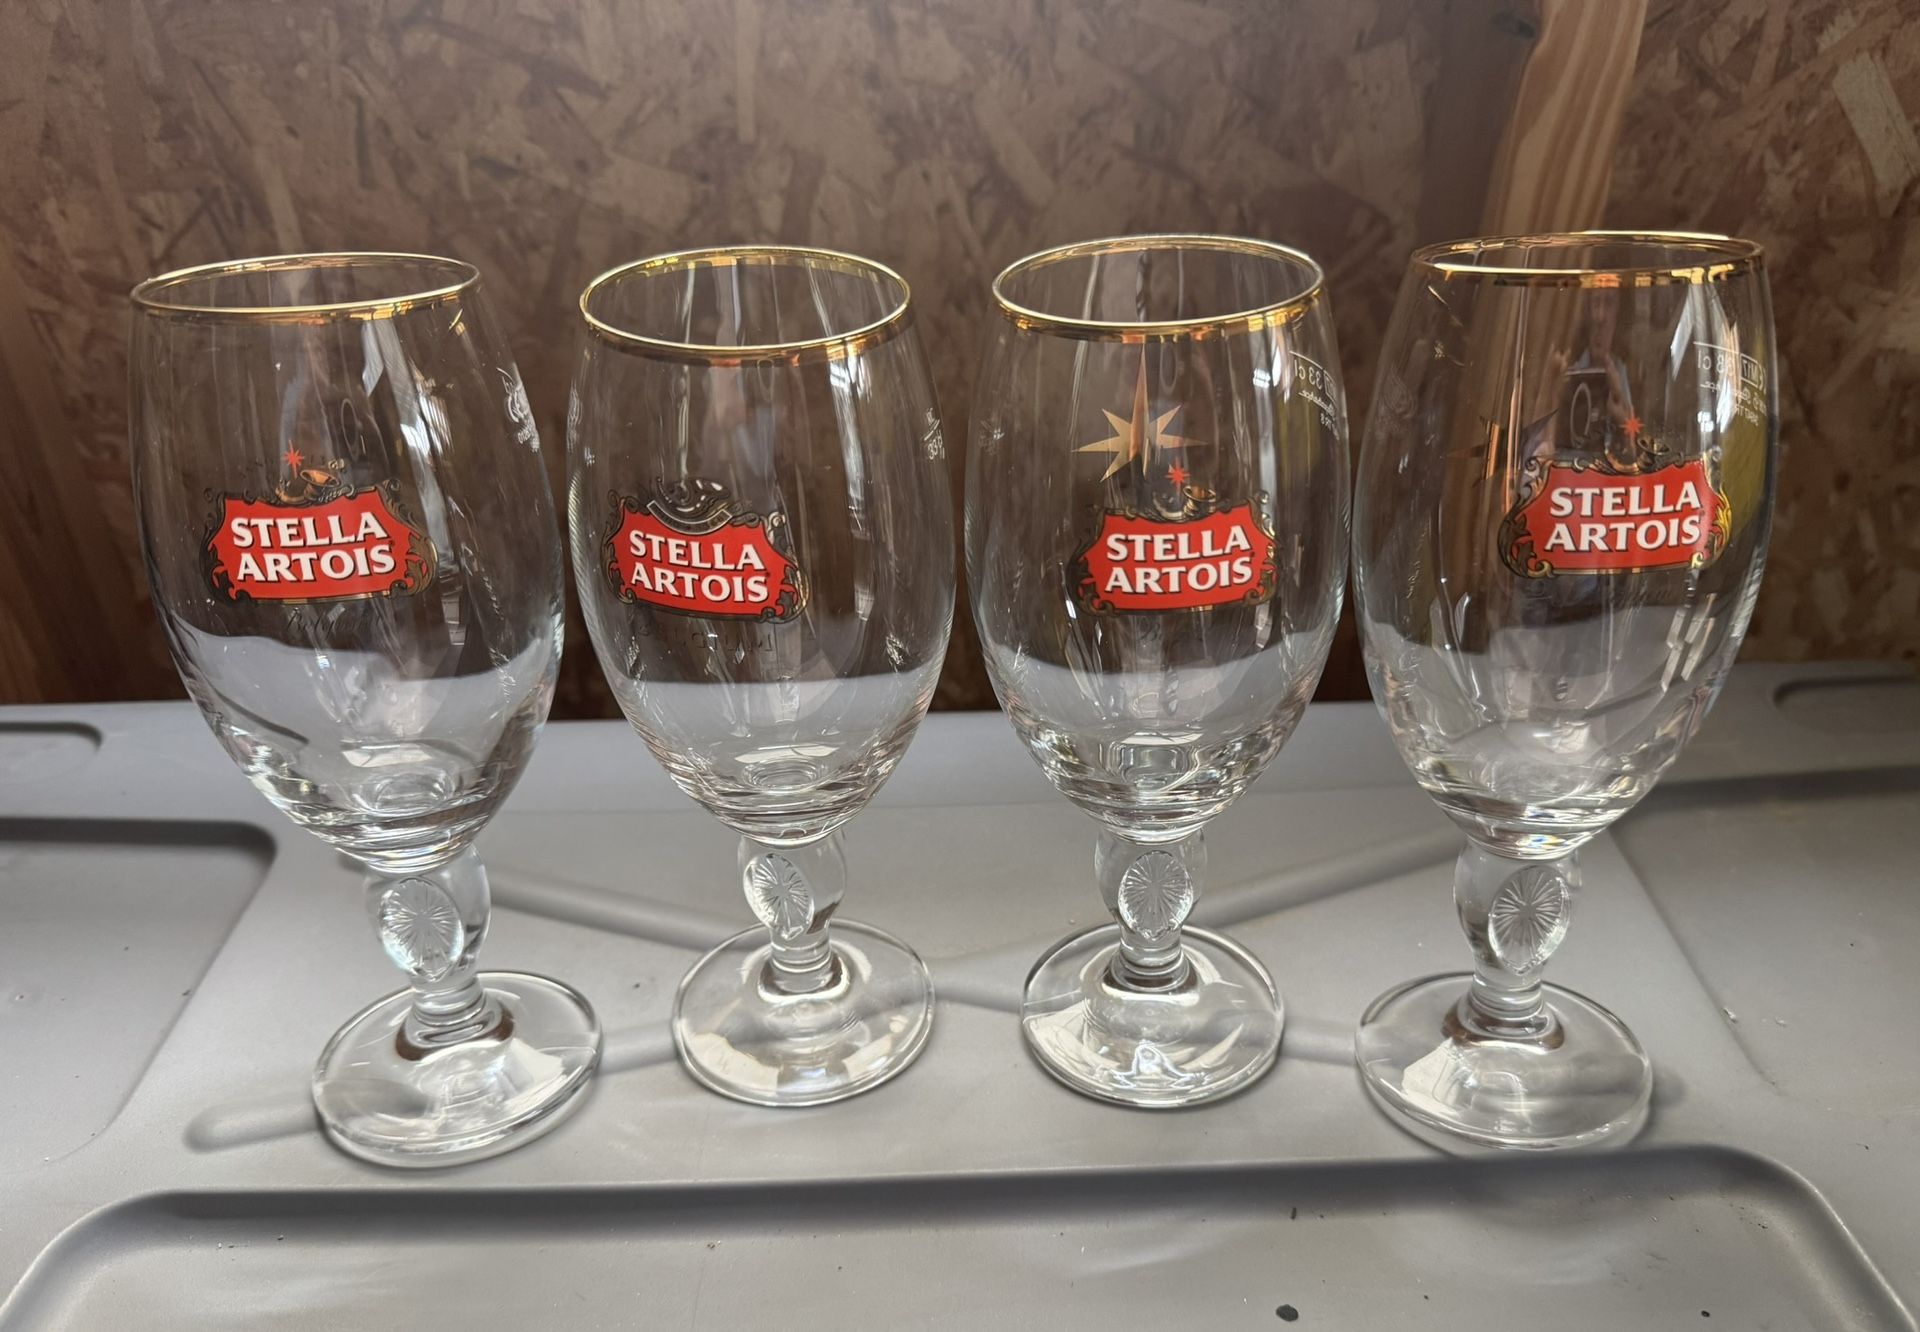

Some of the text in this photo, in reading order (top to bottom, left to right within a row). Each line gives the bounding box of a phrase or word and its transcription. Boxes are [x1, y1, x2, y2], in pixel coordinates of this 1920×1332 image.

[1550, 480, 1702, 517] STELLA
[231, 512, 388, 547] STELLA
[1106, 525, 1251, 561] STELLA
[1545, 514, 1702, 552] ARTOIS
[236, 544, 396, 582] ARTOIS
[629, 529, 766, 570] STELLA
[631, 561, 769, 602] ARTOIS
[1105, 556, 1254, 594] ARTOIS
